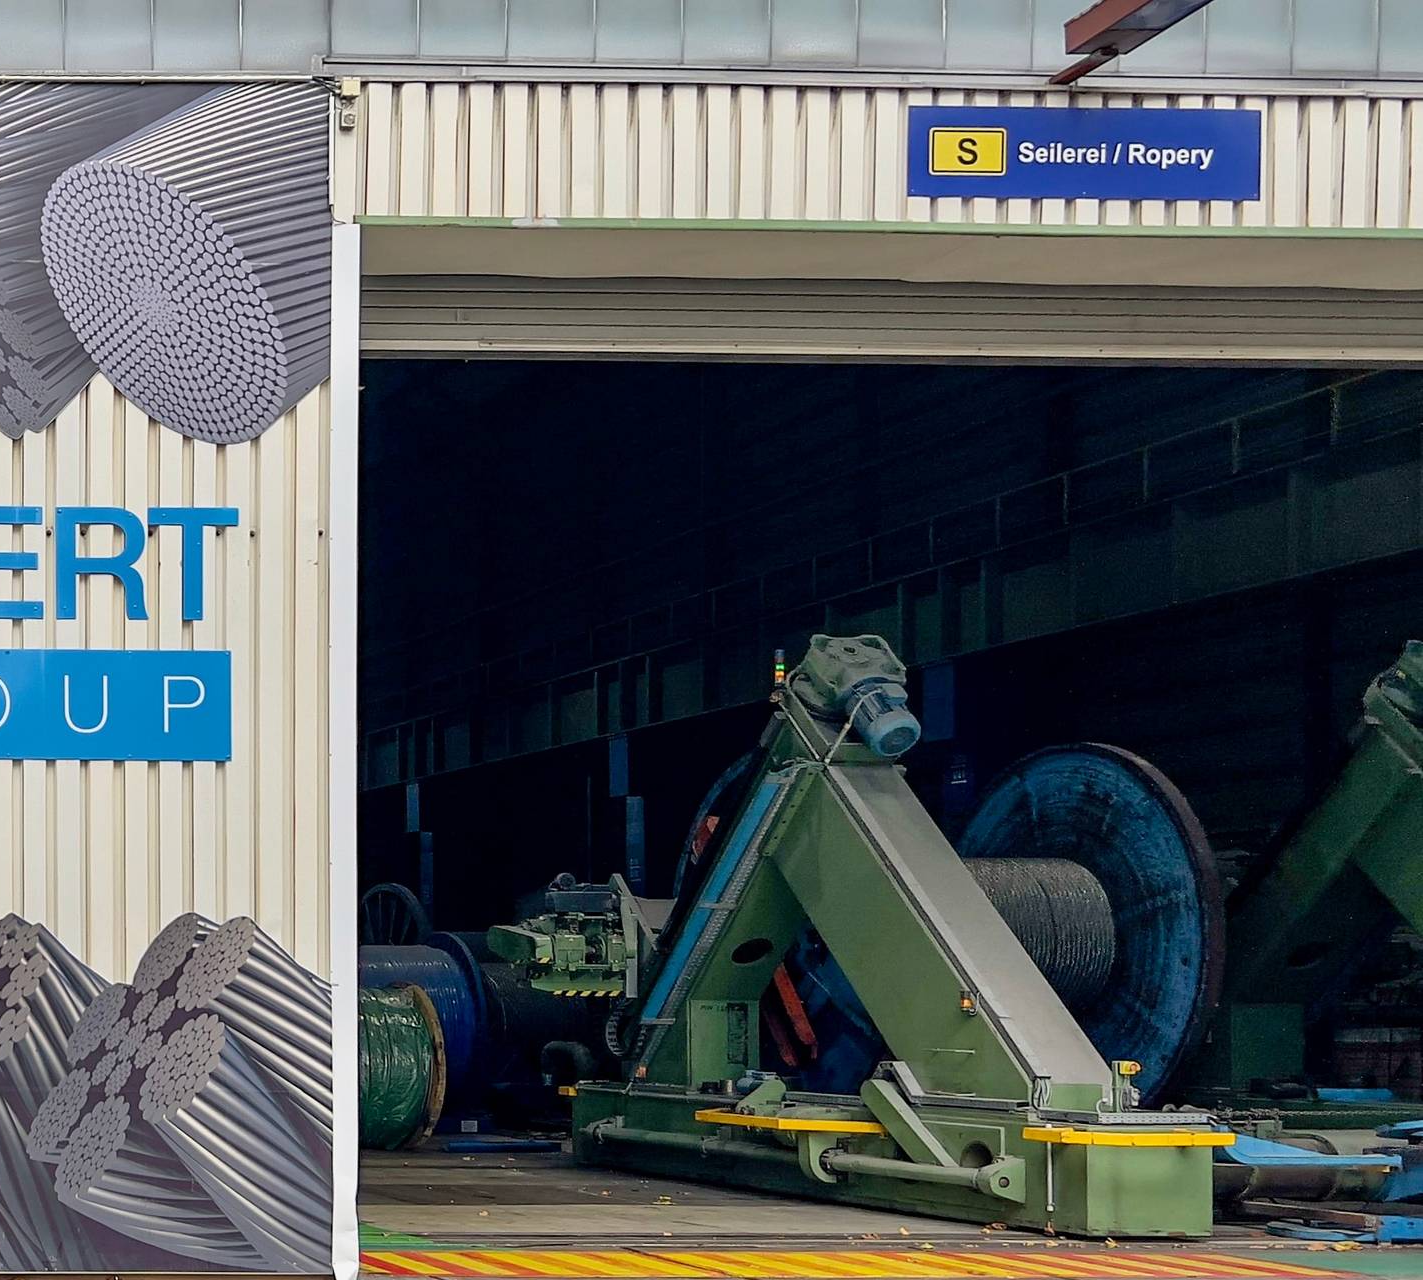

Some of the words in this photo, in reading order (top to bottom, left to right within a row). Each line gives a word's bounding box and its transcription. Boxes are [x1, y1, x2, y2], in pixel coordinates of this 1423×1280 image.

[957, 138, 978, 165] S
[1018, 142, 1107, 164] Seilerei
[1128, 144, 1214, 170] Ropery
